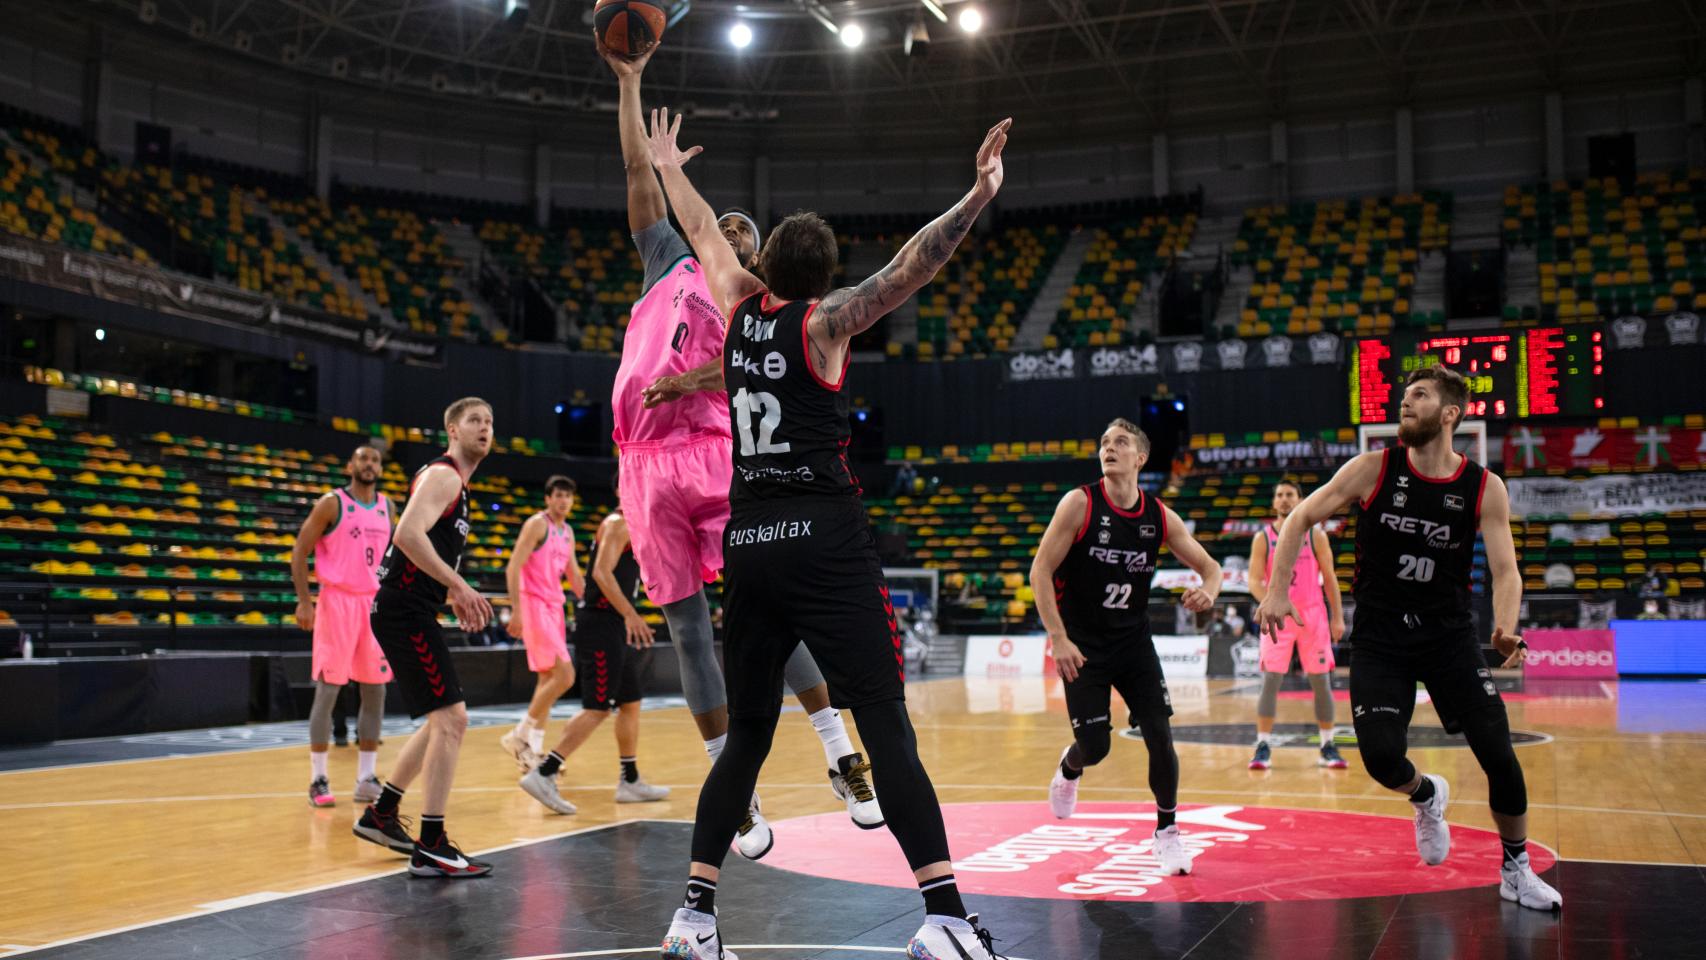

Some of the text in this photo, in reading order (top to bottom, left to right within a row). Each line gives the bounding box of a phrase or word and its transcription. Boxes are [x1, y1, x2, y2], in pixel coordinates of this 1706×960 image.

[671, 322, 689, 354] 0
[732, 387, 791, 457] 12
[729, 520, 812, 547] euskaltax
[1381, 512, 1450, 541] RETA
[365, 547, 375, 567] 8
[1088, 546, 1148, 570] RETA
[1396, 554, 1436, 582] 20
[1102, 583, 1133, 610] 22
[1525, 648, 1614, 666] endesa
